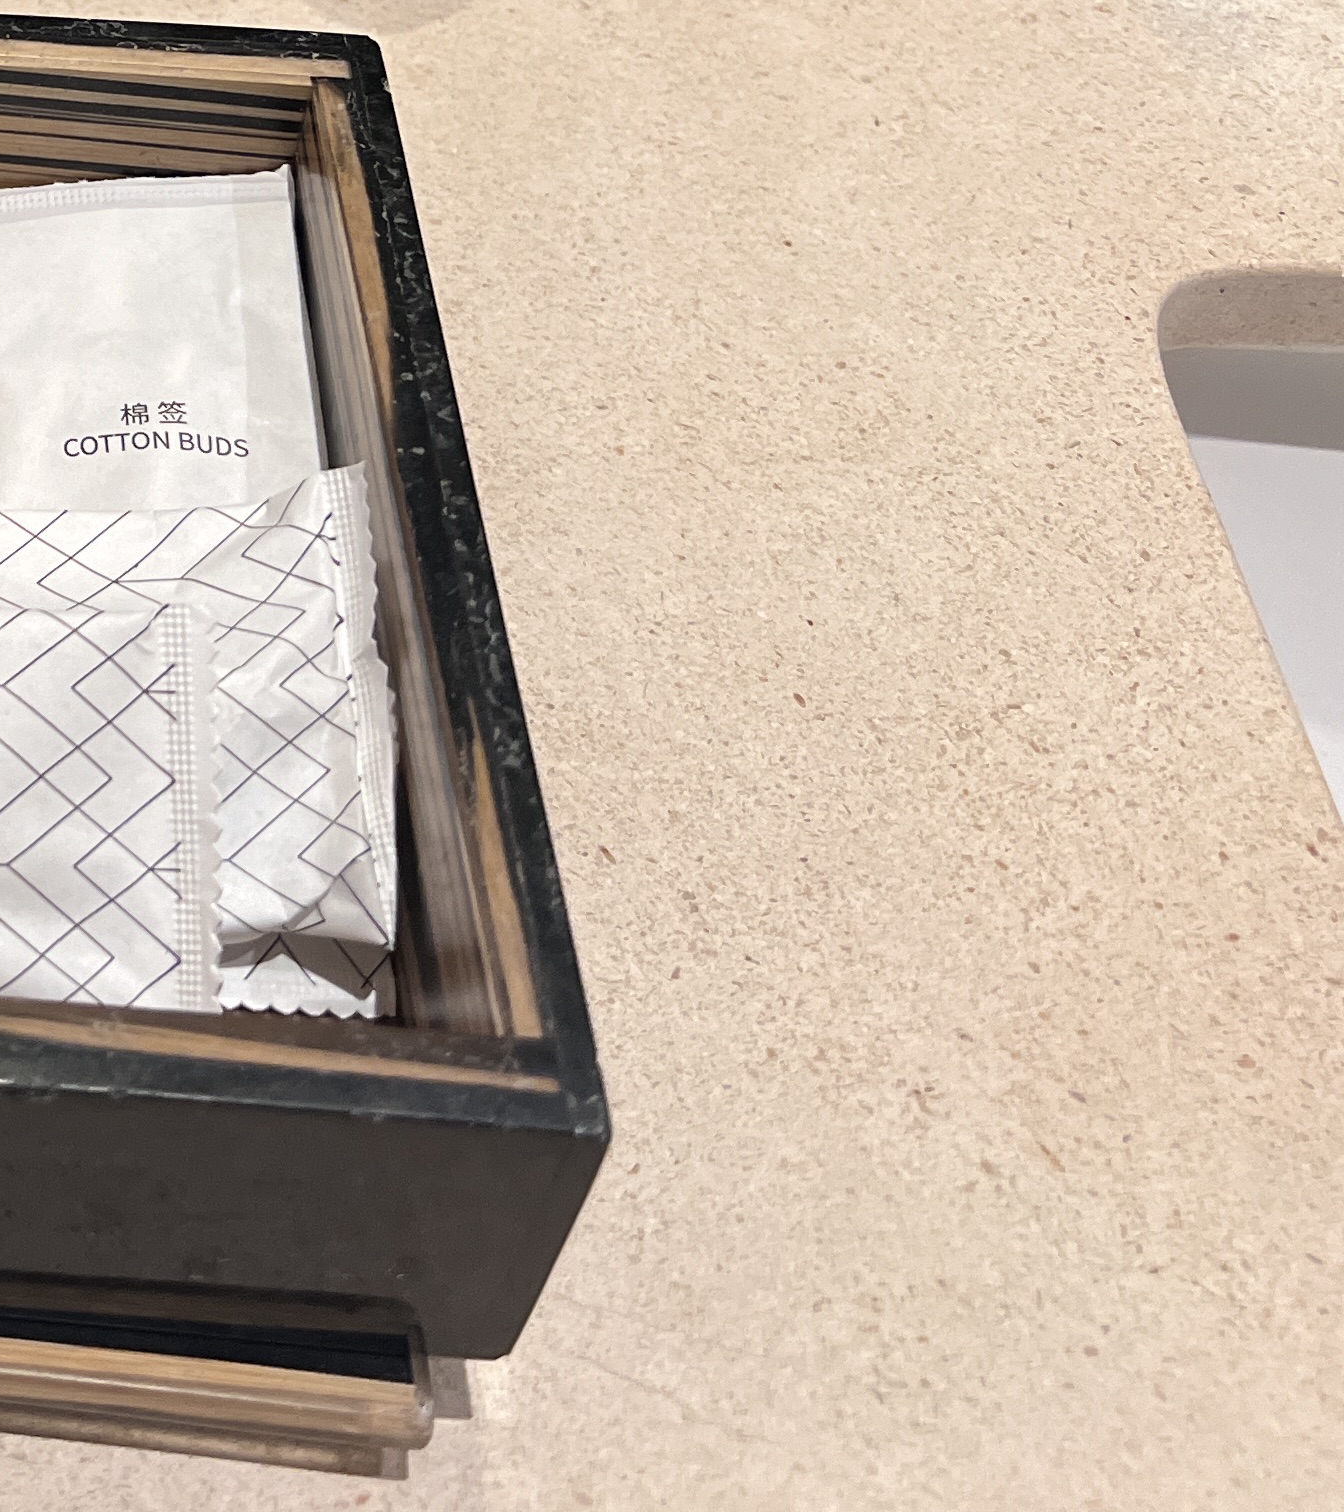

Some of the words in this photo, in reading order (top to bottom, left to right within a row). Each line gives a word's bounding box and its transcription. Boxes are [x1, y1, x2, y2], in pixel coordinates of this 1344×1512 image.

[120, 400, 187, 426] 棉签
[63, 431, 170, 457] COTTON
[178, 432, 249, 458] BUDS
